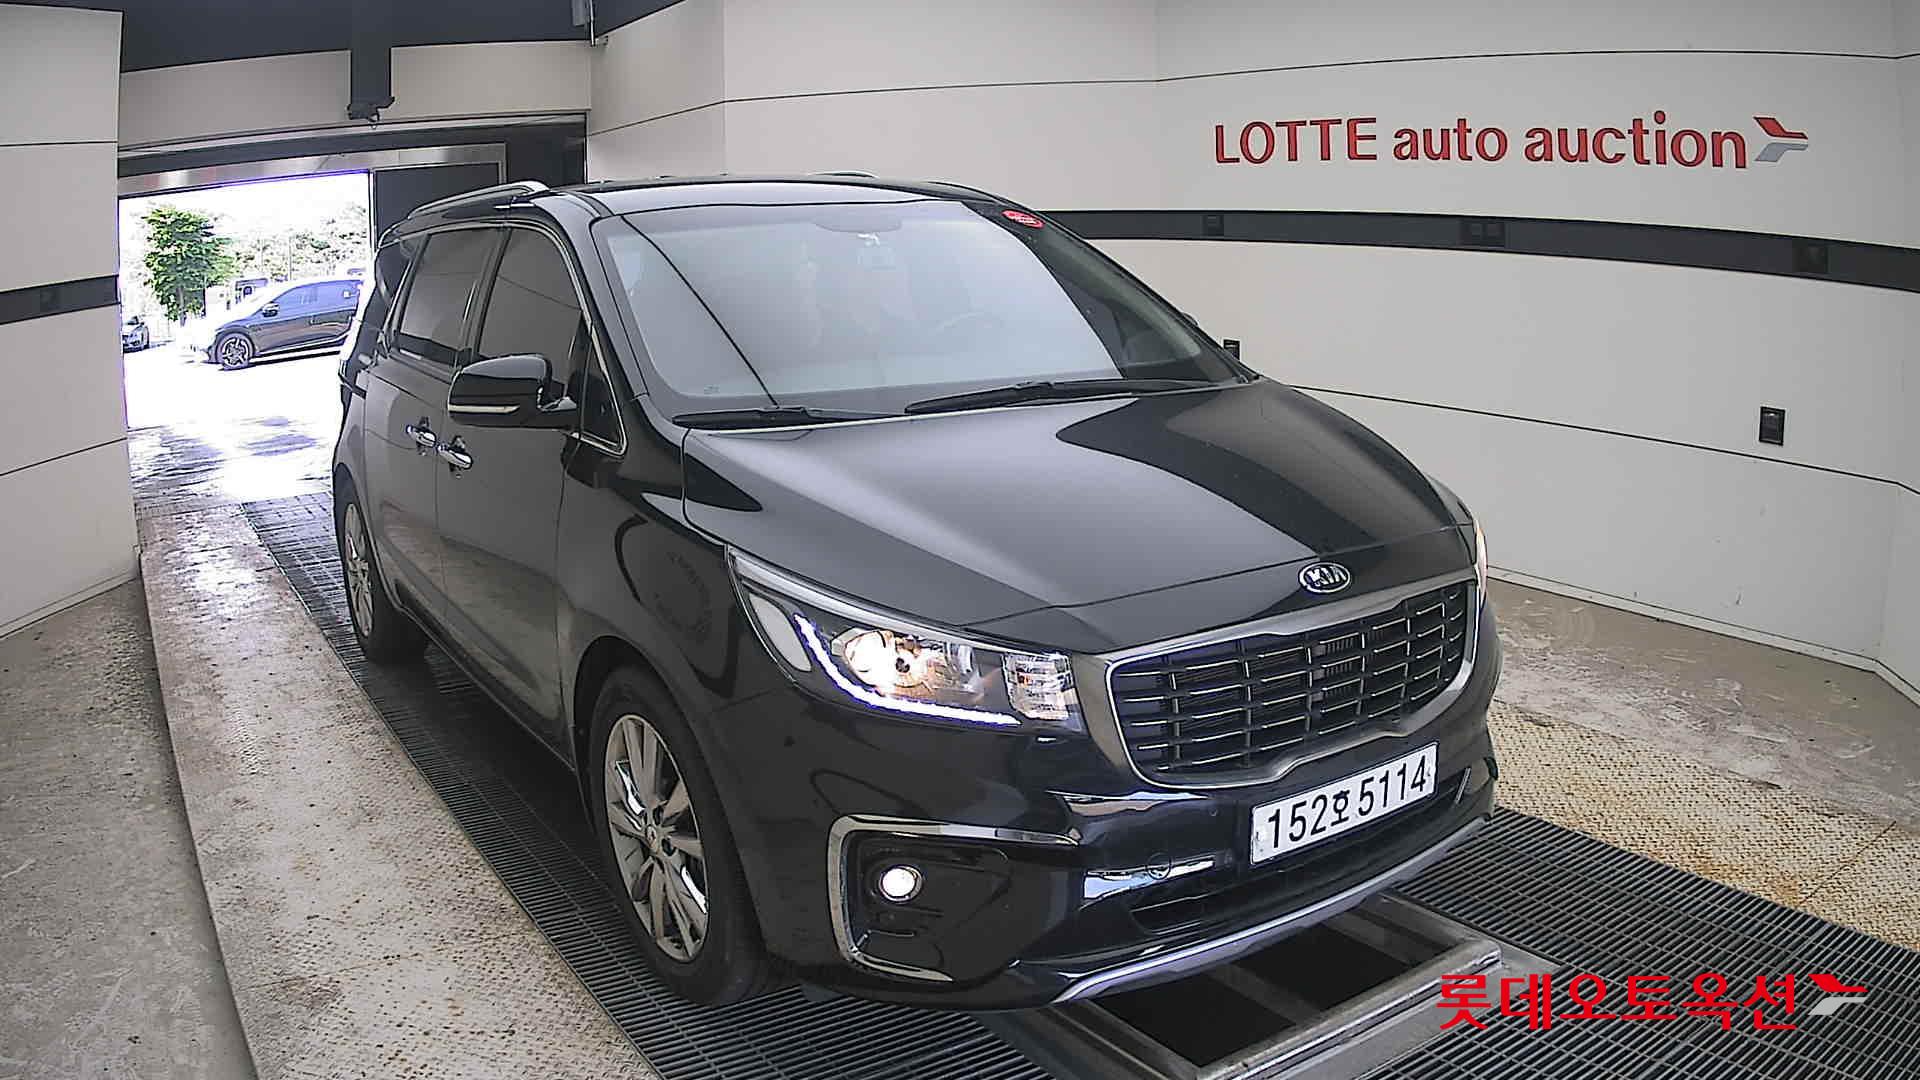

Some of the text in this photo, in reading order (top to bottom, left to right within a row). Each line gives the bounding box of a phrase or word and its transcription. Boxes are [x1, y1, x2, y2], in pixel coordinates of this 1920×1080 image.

[1215, 110, 1748, 169] LOTTE auto auction
[1304, 565, 1347, 587] KIA
